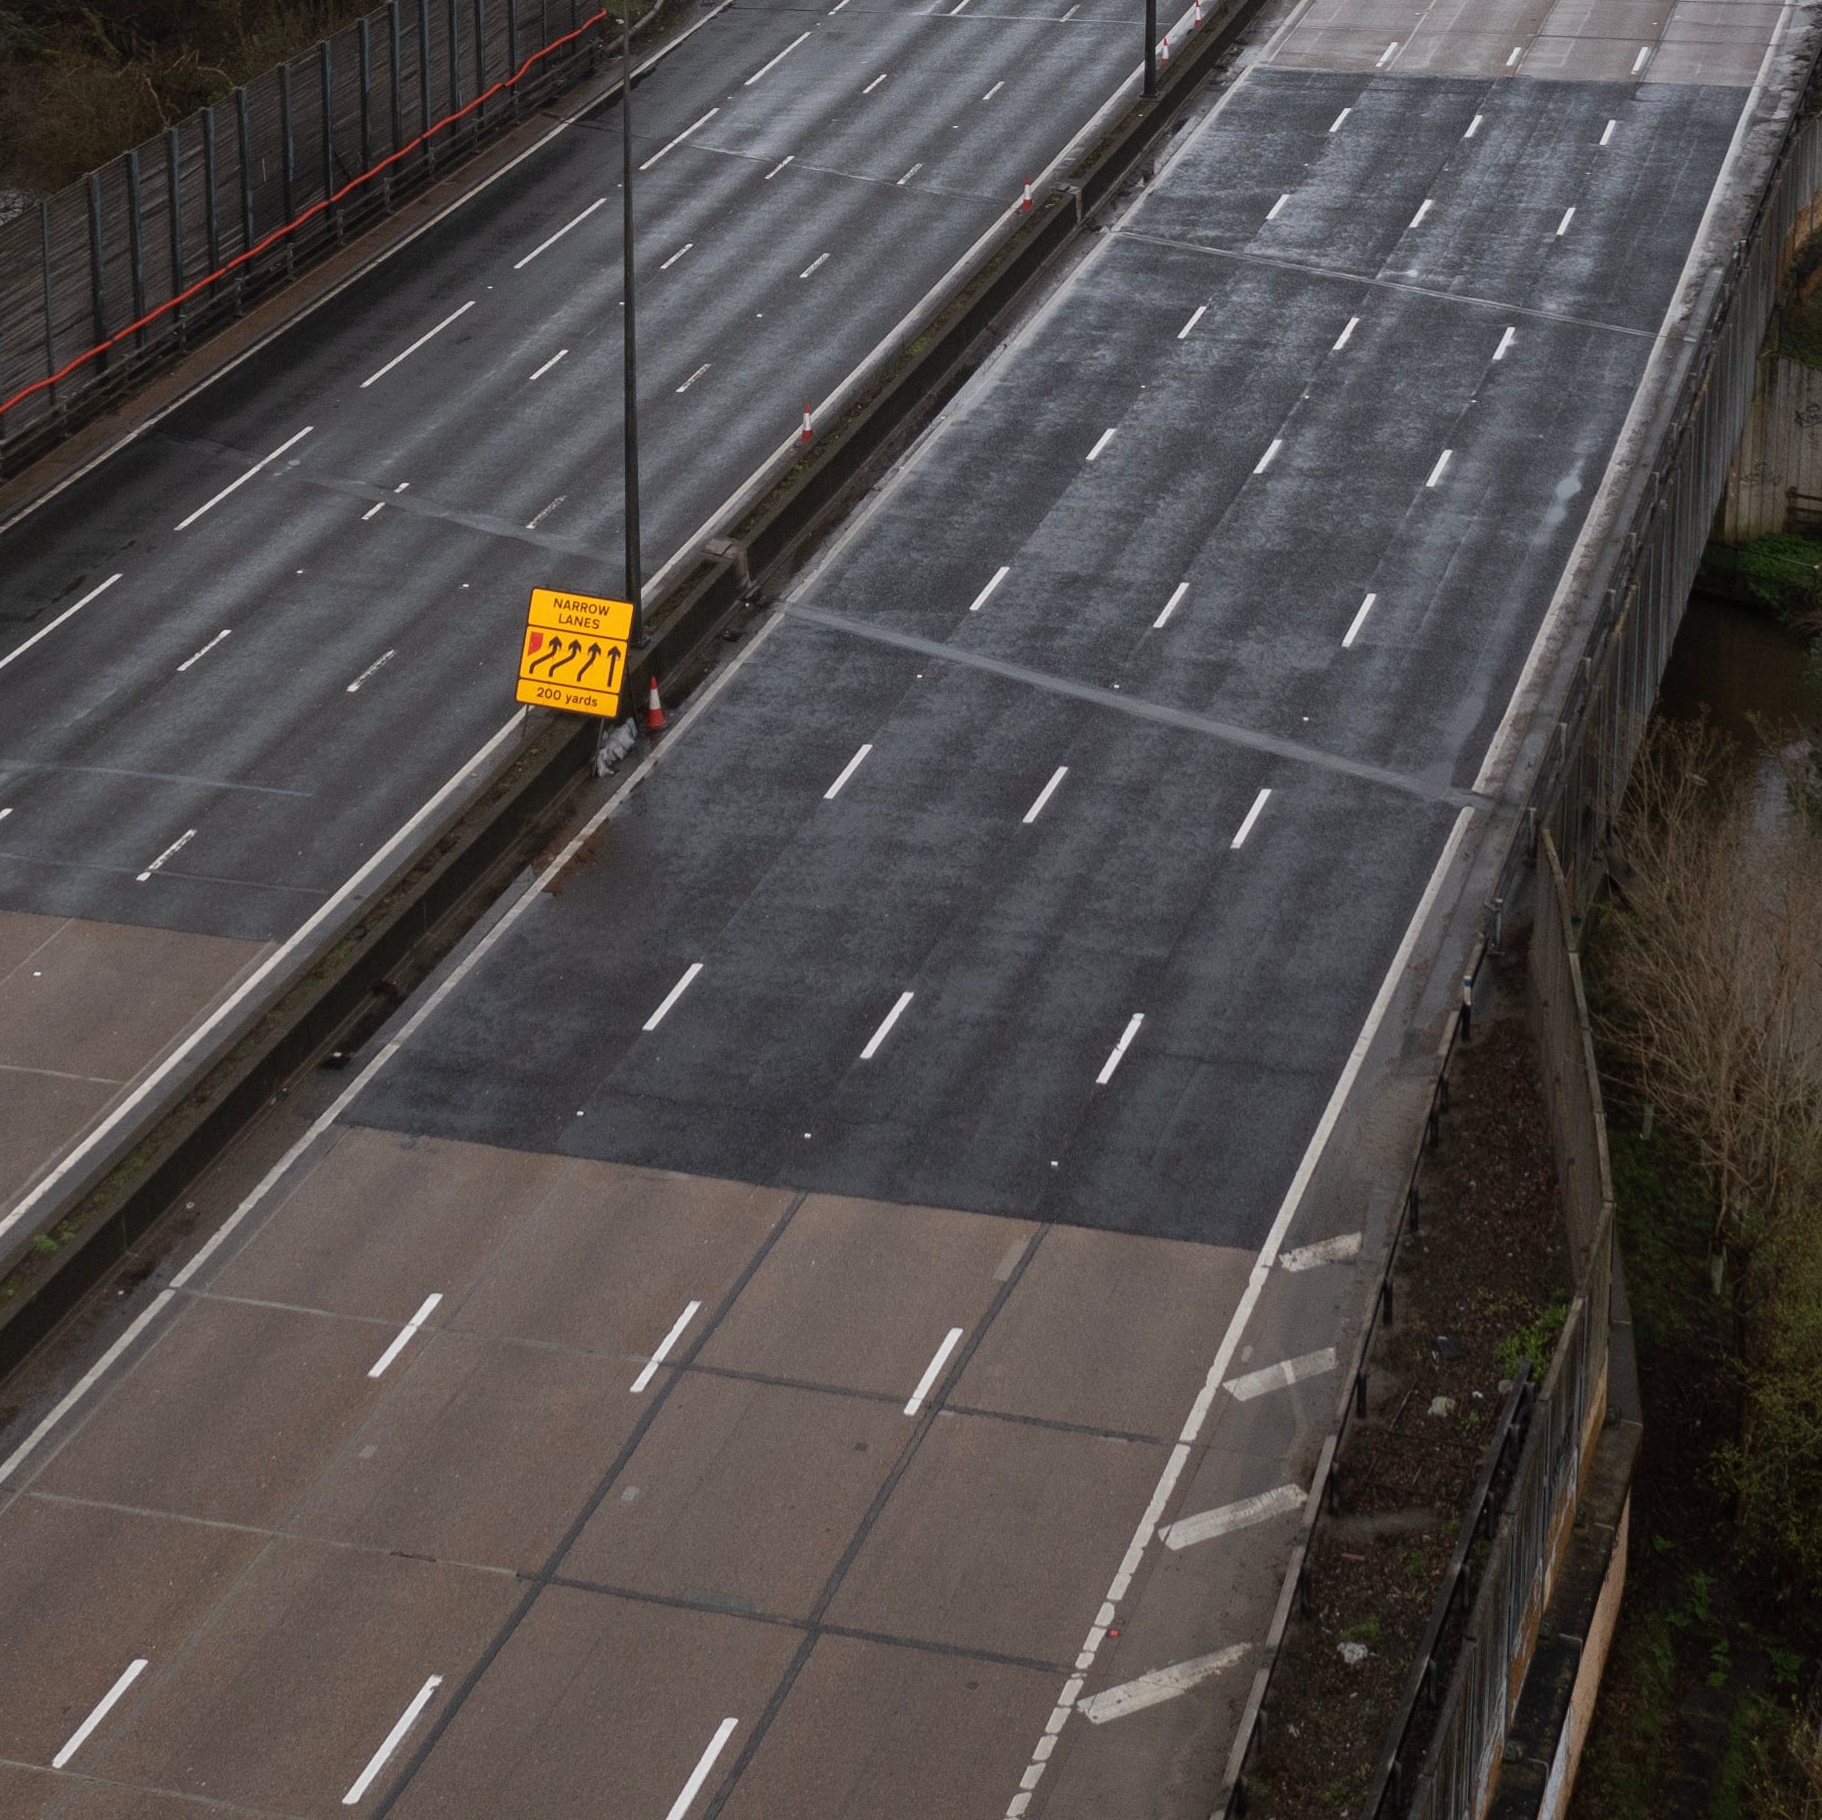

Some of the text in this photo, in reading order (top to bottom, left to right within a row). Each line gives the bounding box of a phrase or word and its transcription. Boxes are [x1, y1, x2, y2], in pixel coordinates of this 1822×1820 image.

[553, 597, 611, 616] NARROW
[558, 613, 600, 630] LANES
[536, 687, 599, 707] 200 yards
